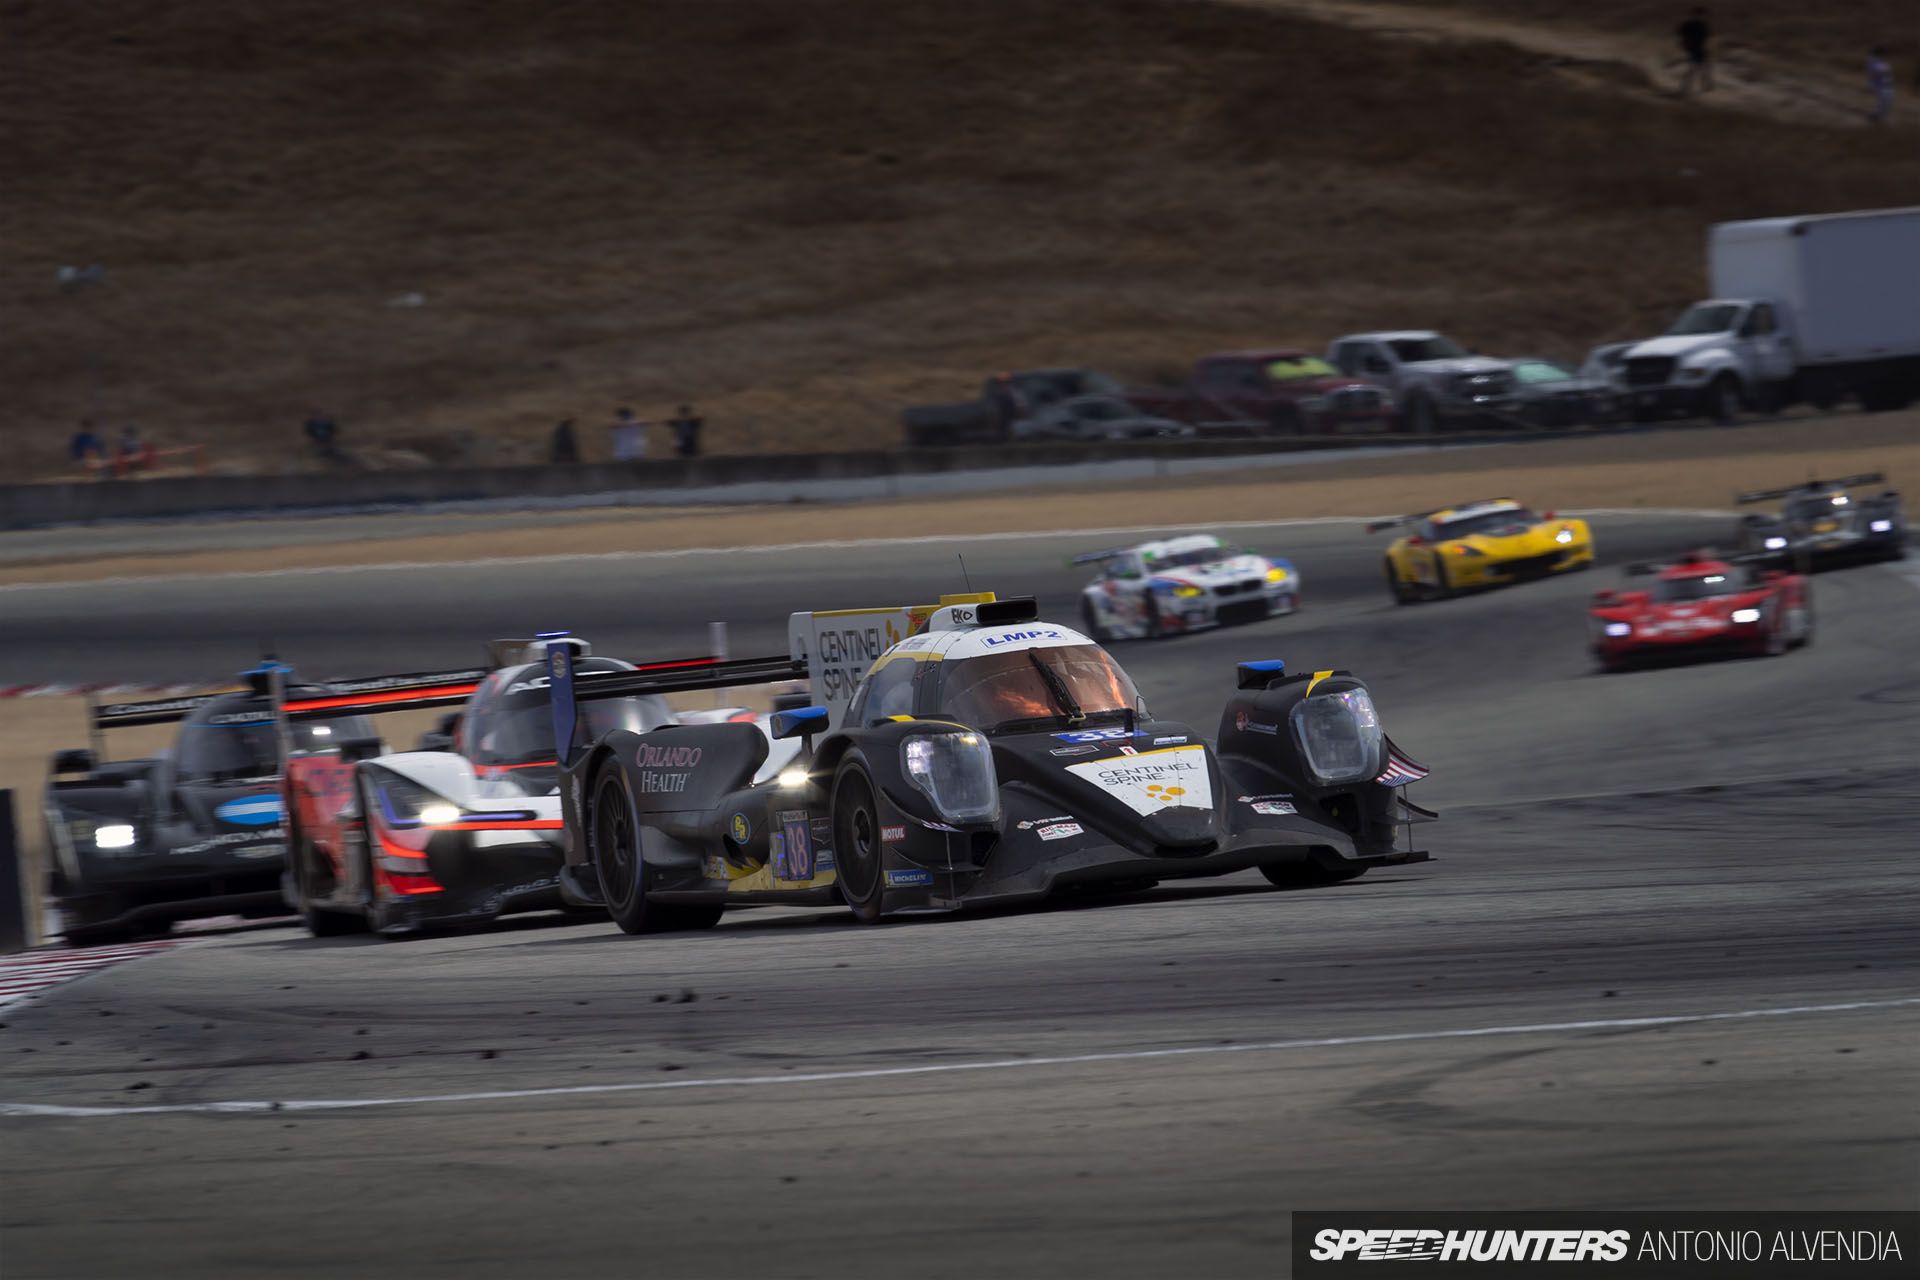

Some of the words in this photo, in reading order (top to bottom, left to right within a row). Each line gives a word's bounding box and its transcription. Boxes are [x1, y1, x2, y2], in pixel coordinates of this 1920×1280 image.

[819, 628, 881, 663] CENTINEL
[986, 630, 1062, 646] LMP2
[1070, 727, 1133, 742] 38
[1097, 762, 1200, 779] CENTINEL
[1104, 772, 1167, 786] SPINE
[882, 827, 905, 840] MOTUL
[788, 825, 809, 876] 38
[893, 873, 927, 883] MICHELIN
